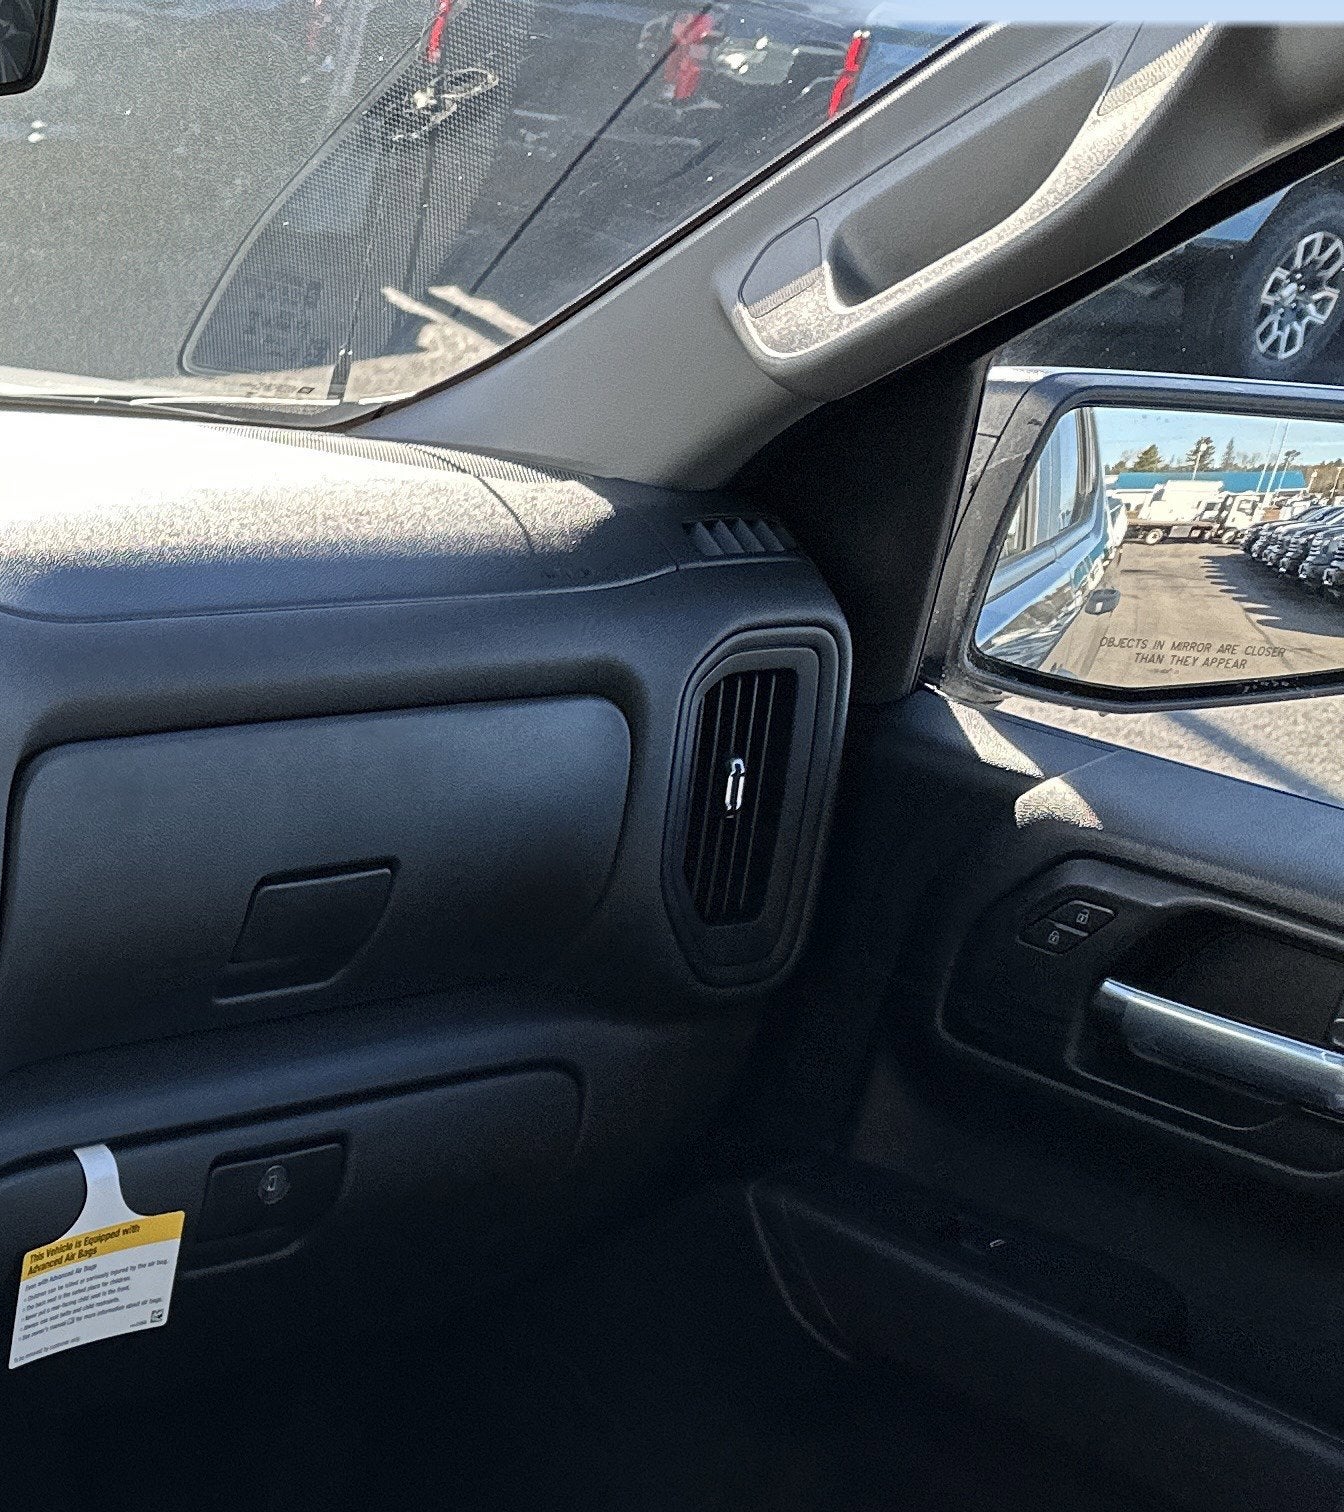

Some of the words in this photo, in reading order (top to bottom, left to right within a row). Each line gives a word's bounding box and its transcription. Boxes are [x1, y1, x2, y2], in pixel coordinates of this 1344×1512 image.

[1100, 636, 1148, 649] OBJECTS
[1153, 640, 1165, 650] IN
[1171, 641, 1212, 653] MIRROR
[1216, 643, 1239, 654] ARE
[1244, 646, 1286, 657] CLOSER
[1134, 653, 1165, 663] THAN
[1170, 654, 1199, 666] THEY
[1202, 657, 1247, 670] APPEAR
[30, 1252, 45, 1264] This
[47, 1242, 73, 1258] Vehicle
[75, 1240, 82, 1248] is
[84, 1227, 121, 1246] Equipped
[122, 1224, 140, 1234] with
[28, 1256, 63, 1276] Advanced
[64, 1252, 75, 1263] Air
[78, 1246, 97, 1259] Bags
